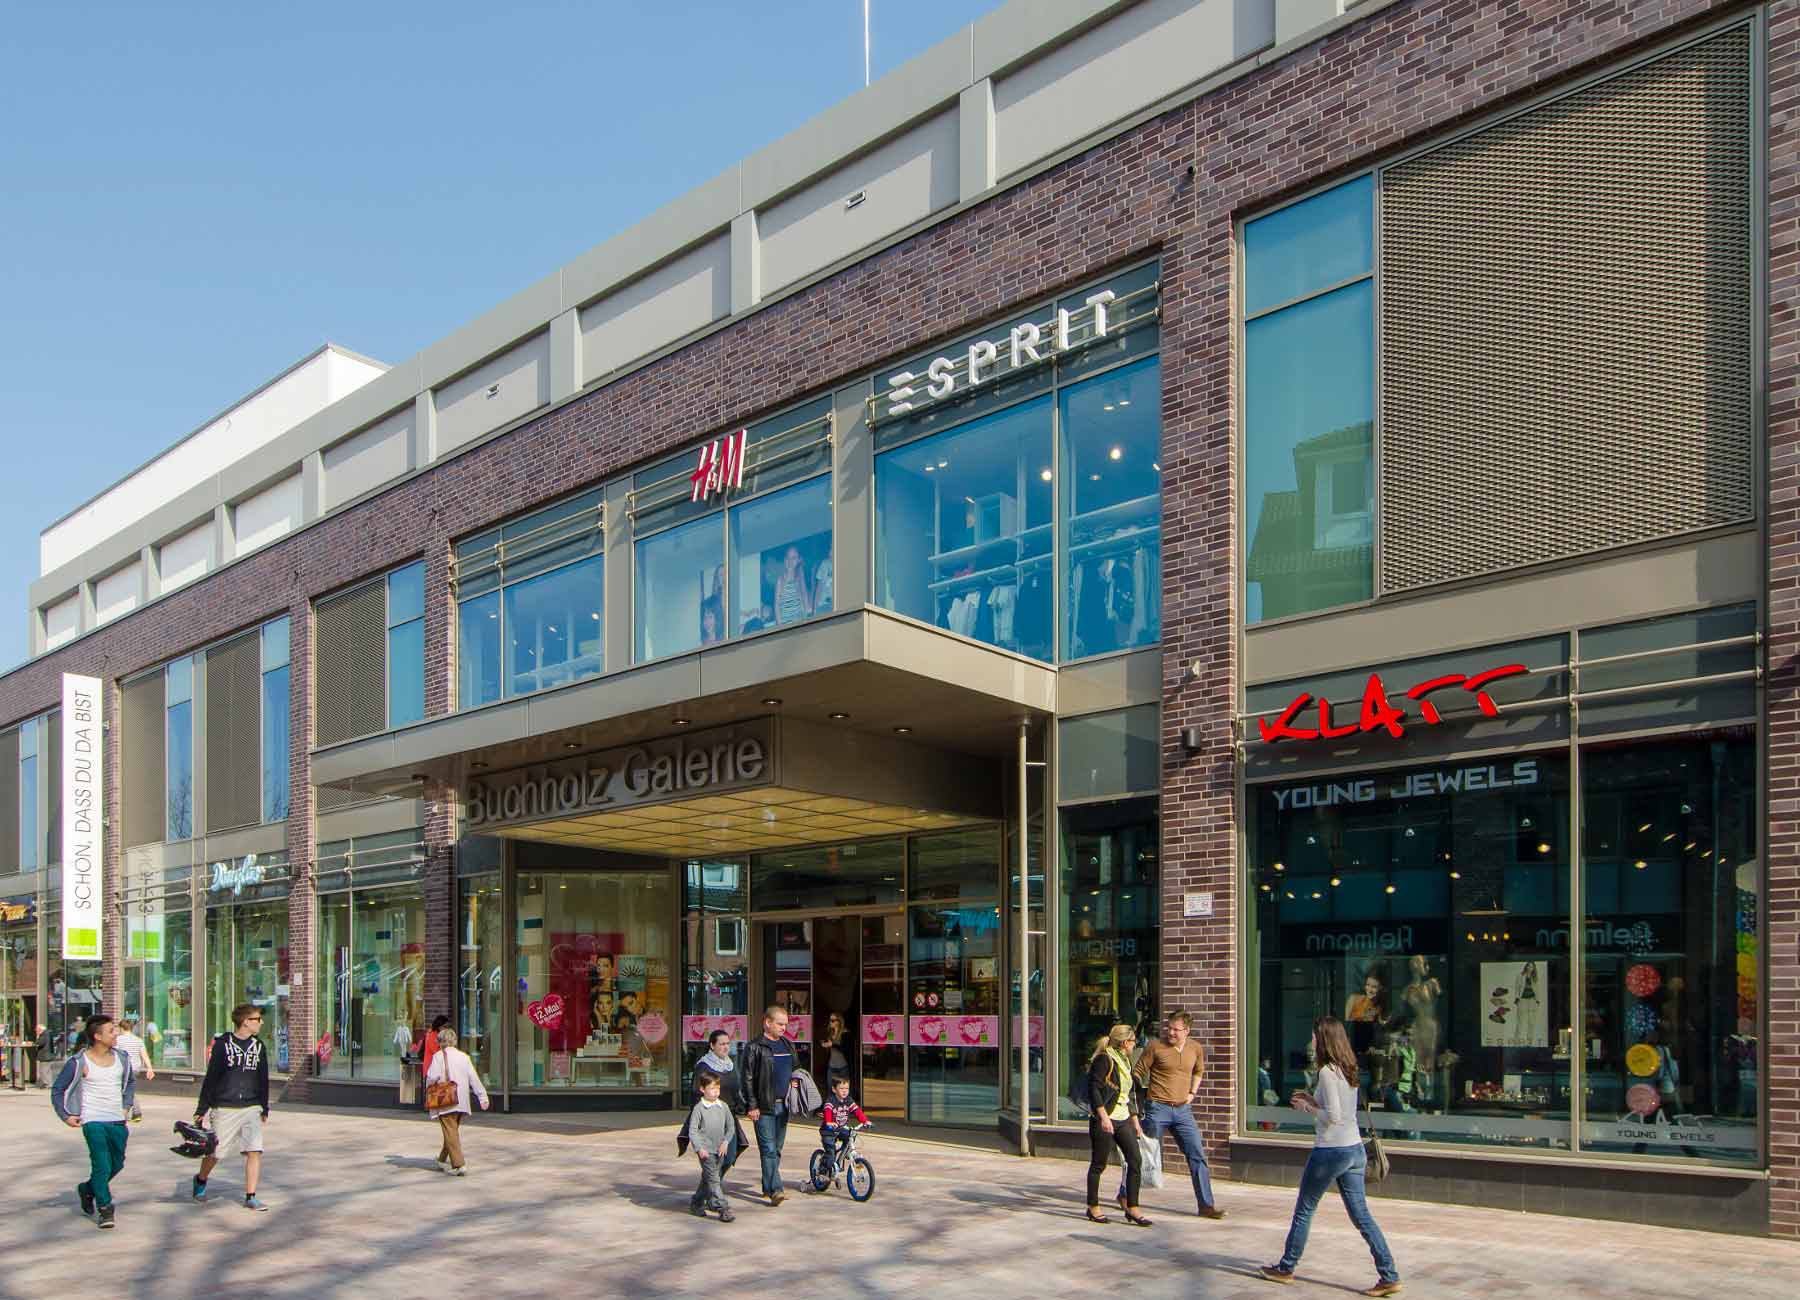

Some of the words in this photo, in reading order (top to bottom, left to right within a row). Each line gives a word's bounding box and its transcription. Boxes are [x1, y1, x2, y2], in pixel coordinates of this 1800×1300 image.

[888, 290, 1115, 416] ESPRIT
[690, 428, 747, 502] H&M
[74, 690, 92, 722] BIST
[1259, 664, 1528, 743] KLATT
[74, 728, 92, 753] DA
[74, 758, 92, 784] DU
[465, 763, 611, 825] Buchholz
[623, 730, 764, 796] Galerie
[1272, 780, 1376, 810] YOUNG
[1390, 761, 1538, 798] JEWELS
[74, 788, 92, 833] DASS
[1664, 1132, 1714, 1143] EWELS
